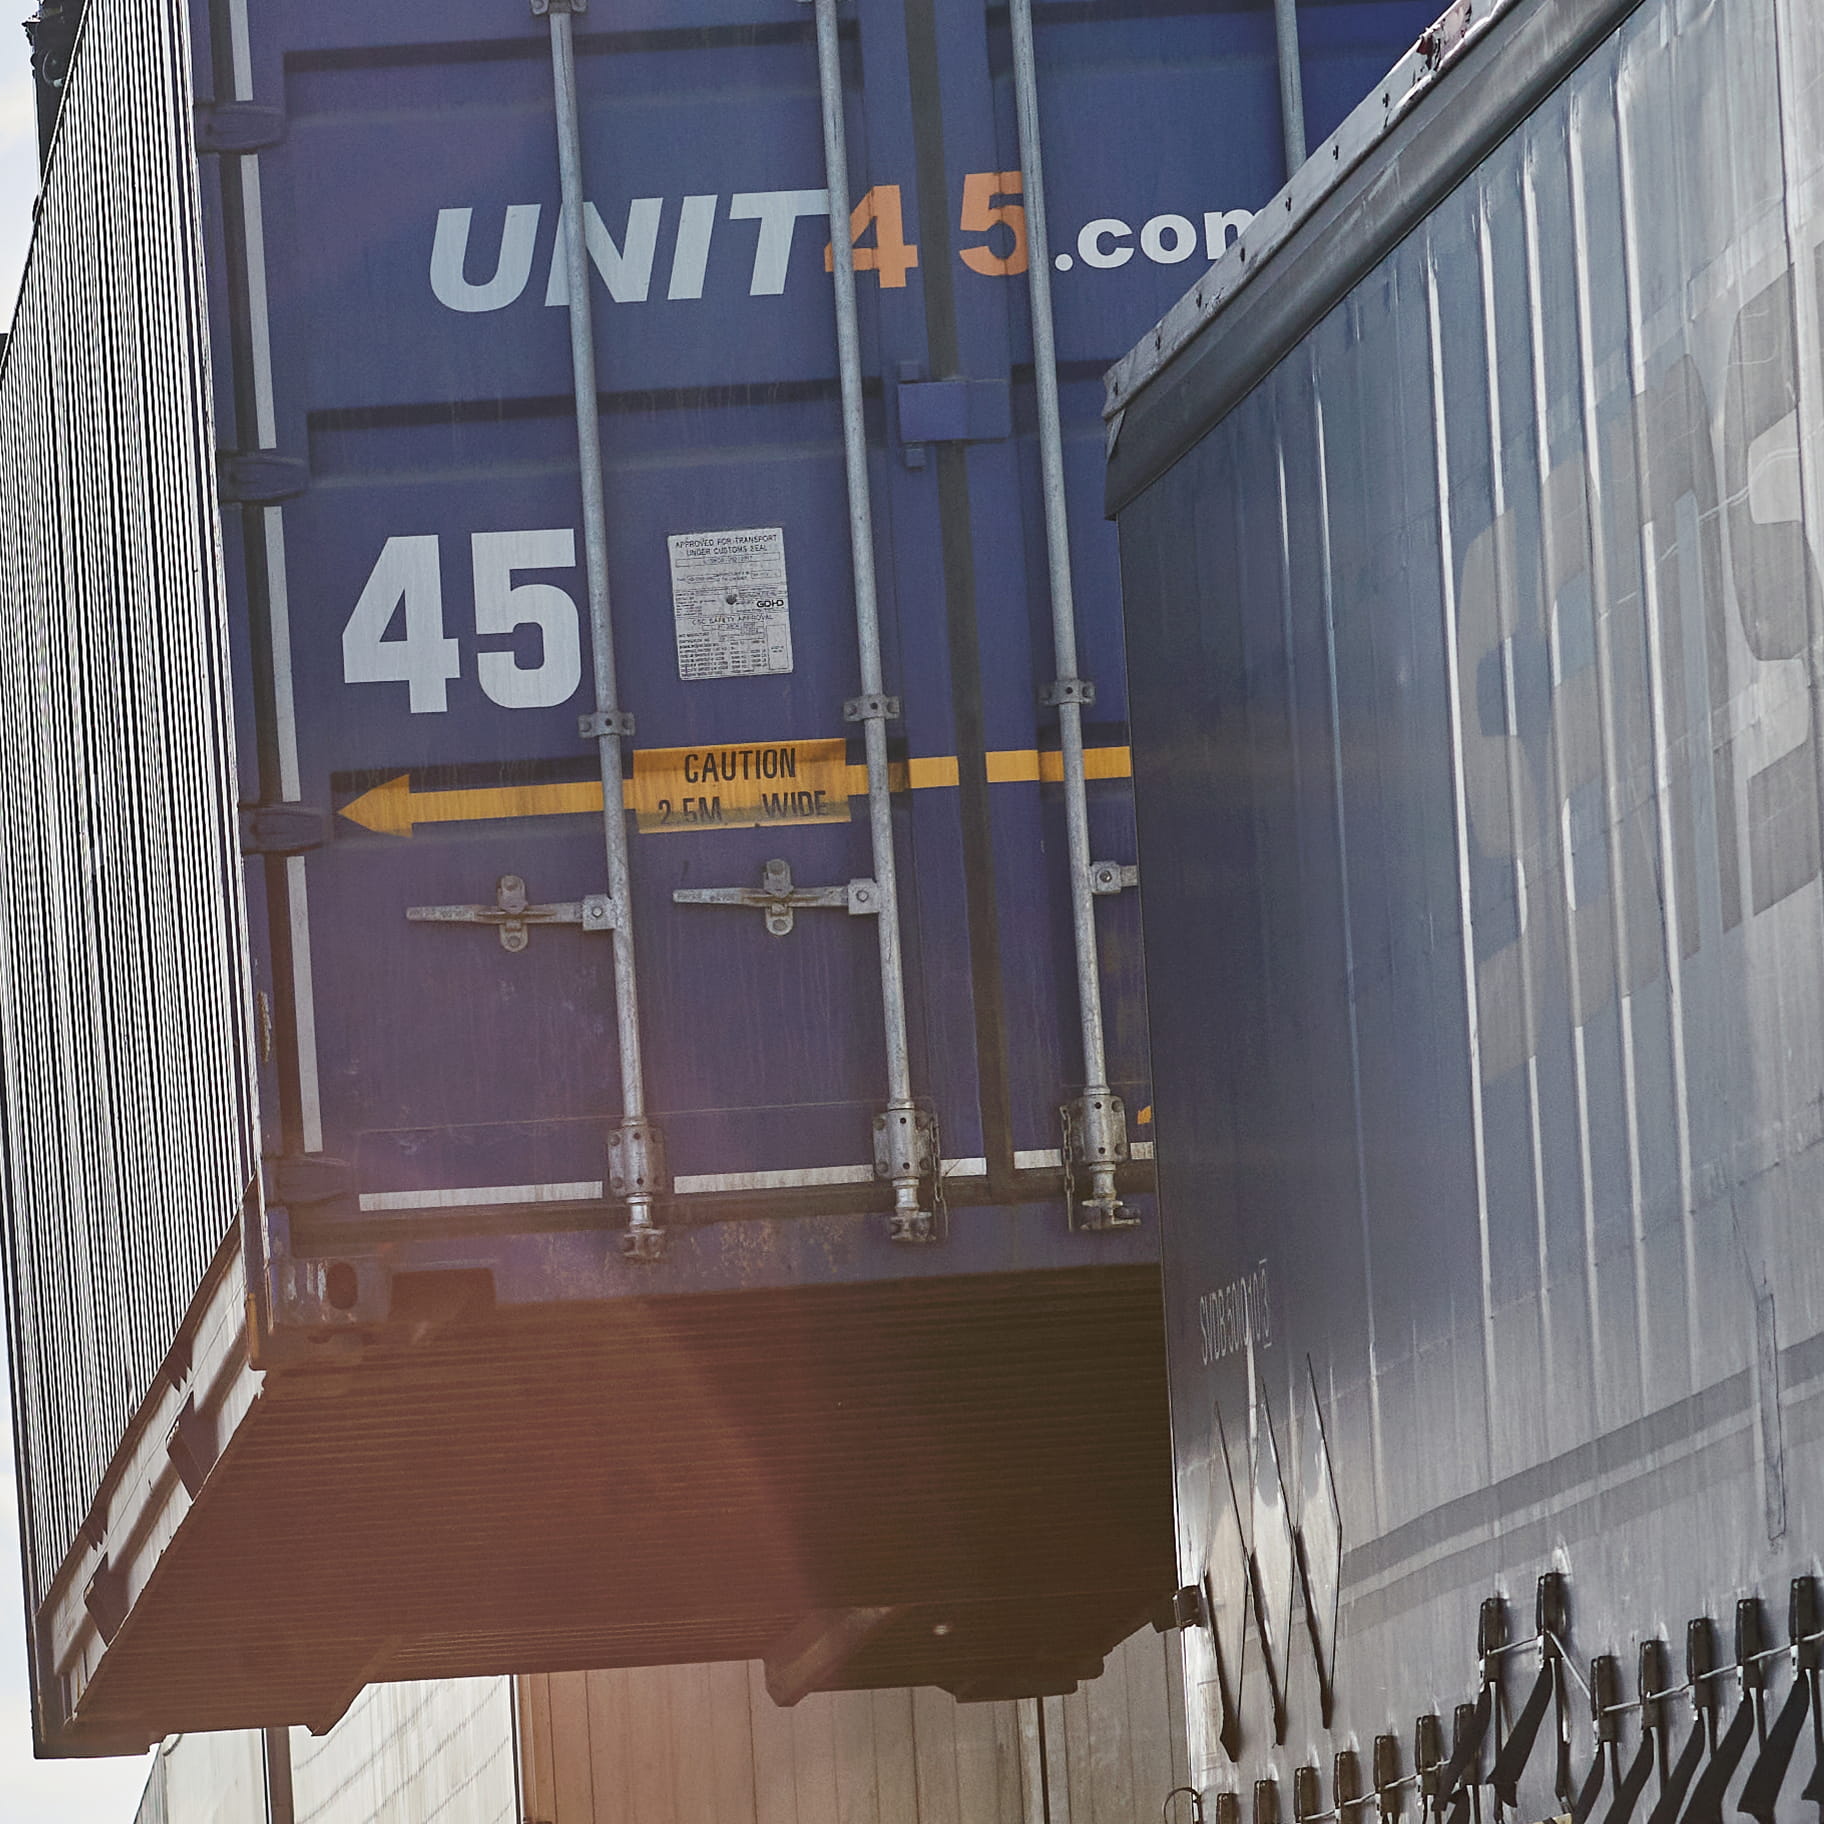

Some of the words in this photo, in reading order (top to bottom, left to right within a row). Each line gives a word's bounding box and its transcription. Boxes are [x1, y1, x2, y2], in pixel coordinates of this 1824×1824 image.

[342, 528, 582, 713] 45
[684, 748, 796, 783] CAUTION
[762, 790, 827, 819] WIDE
